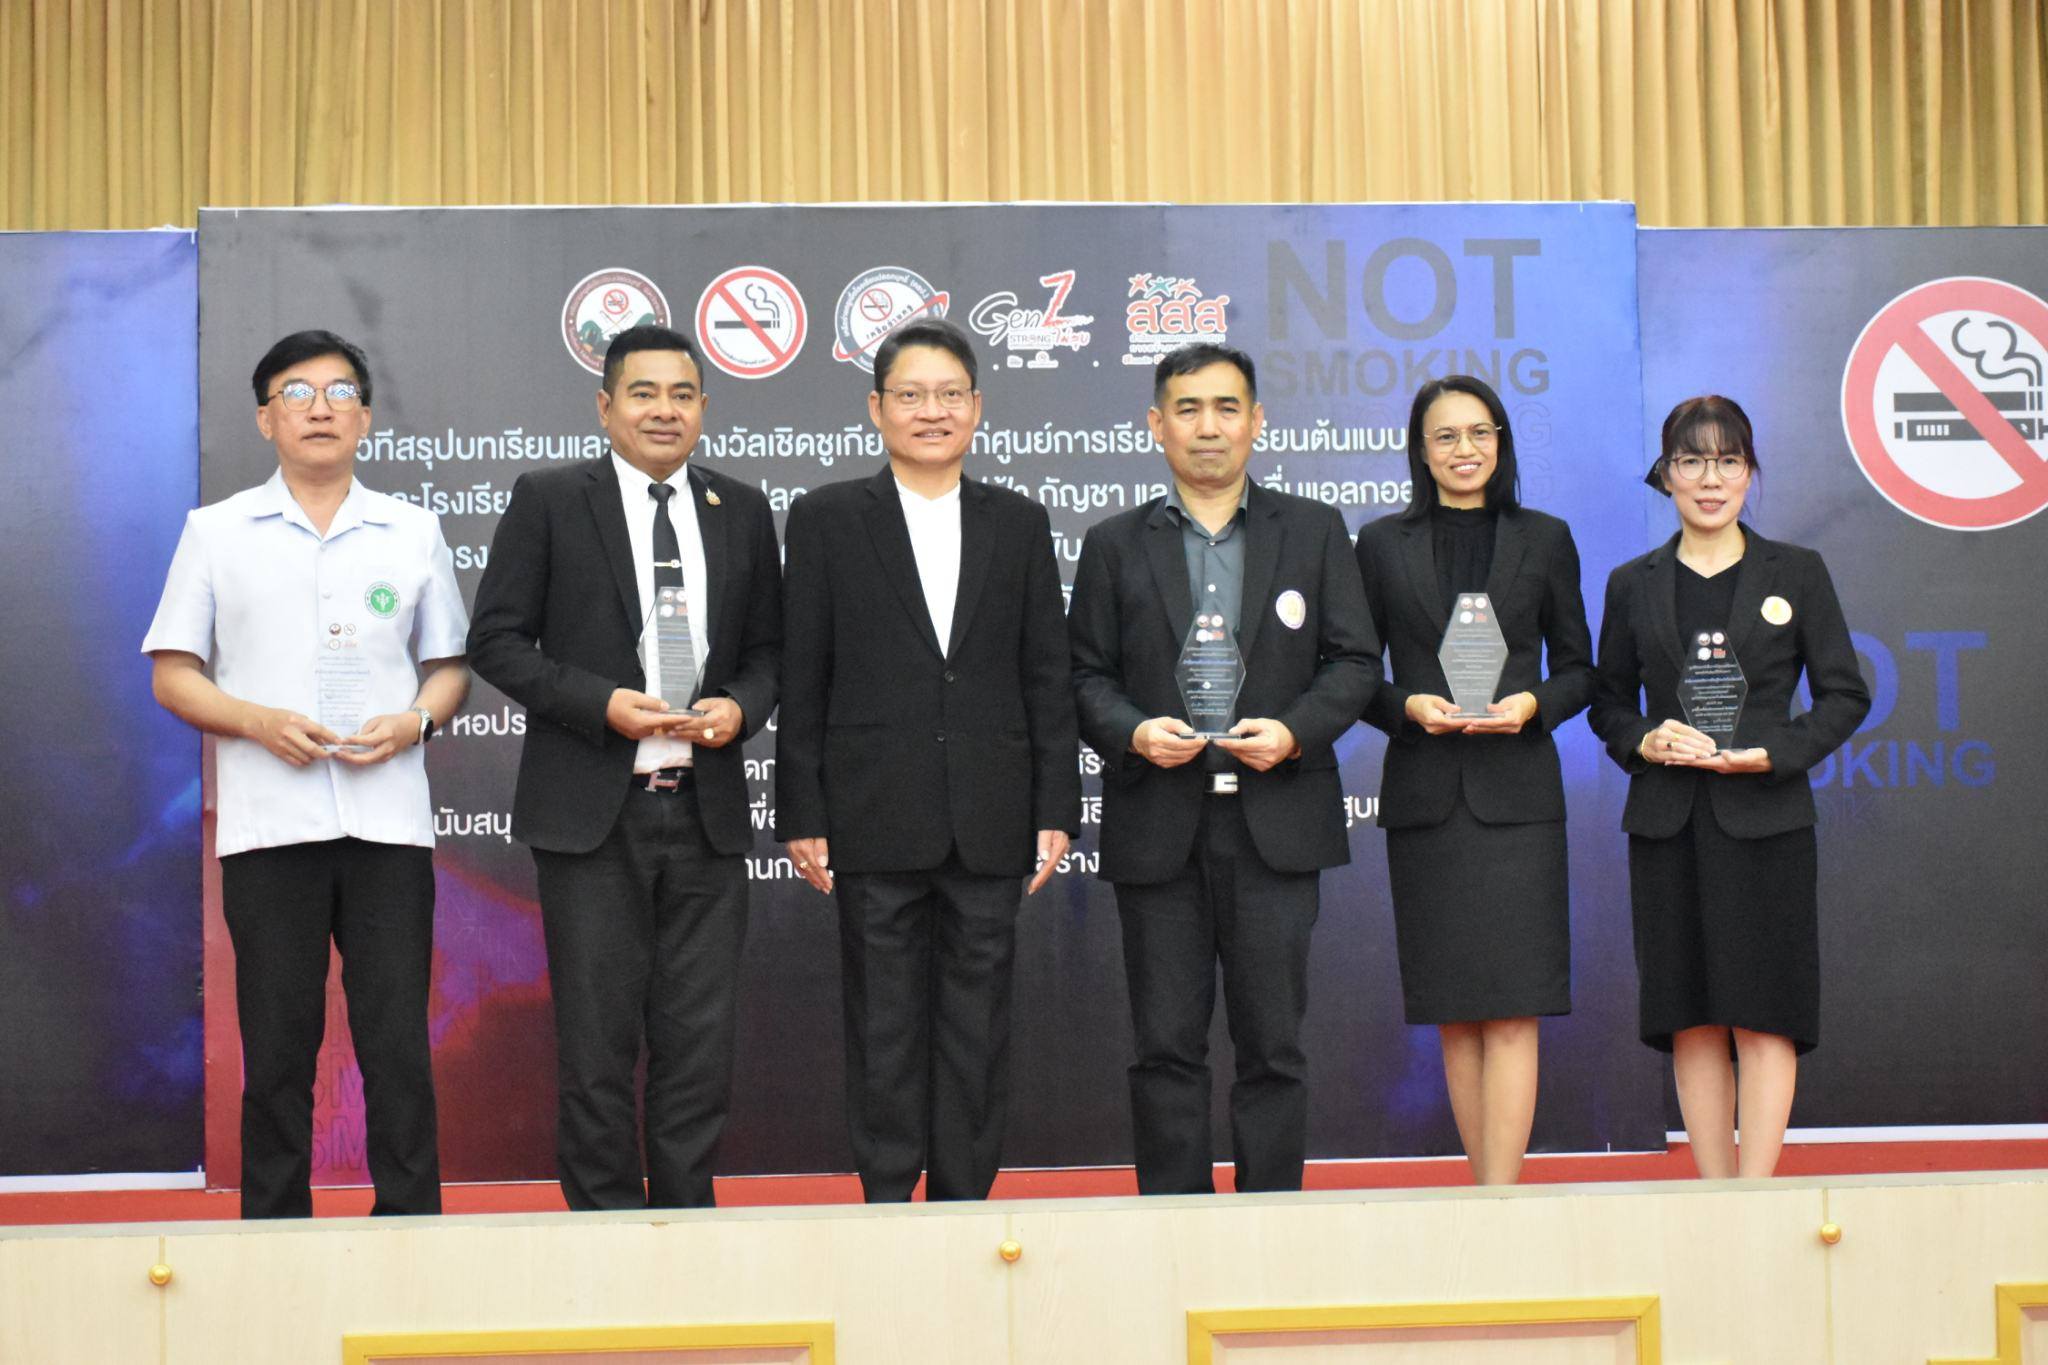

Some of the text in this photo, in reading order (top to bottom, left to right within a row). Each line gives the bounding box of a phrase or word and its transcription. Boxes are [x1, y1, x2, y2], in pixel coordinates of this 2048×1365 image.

[1267, 238, 1541, 342] NOT
[1126, 295, 1230, 334] สสส
[1262, 348, 1550, 396] SMOKING
[1038, 476, 1124, 513] กัญชา
